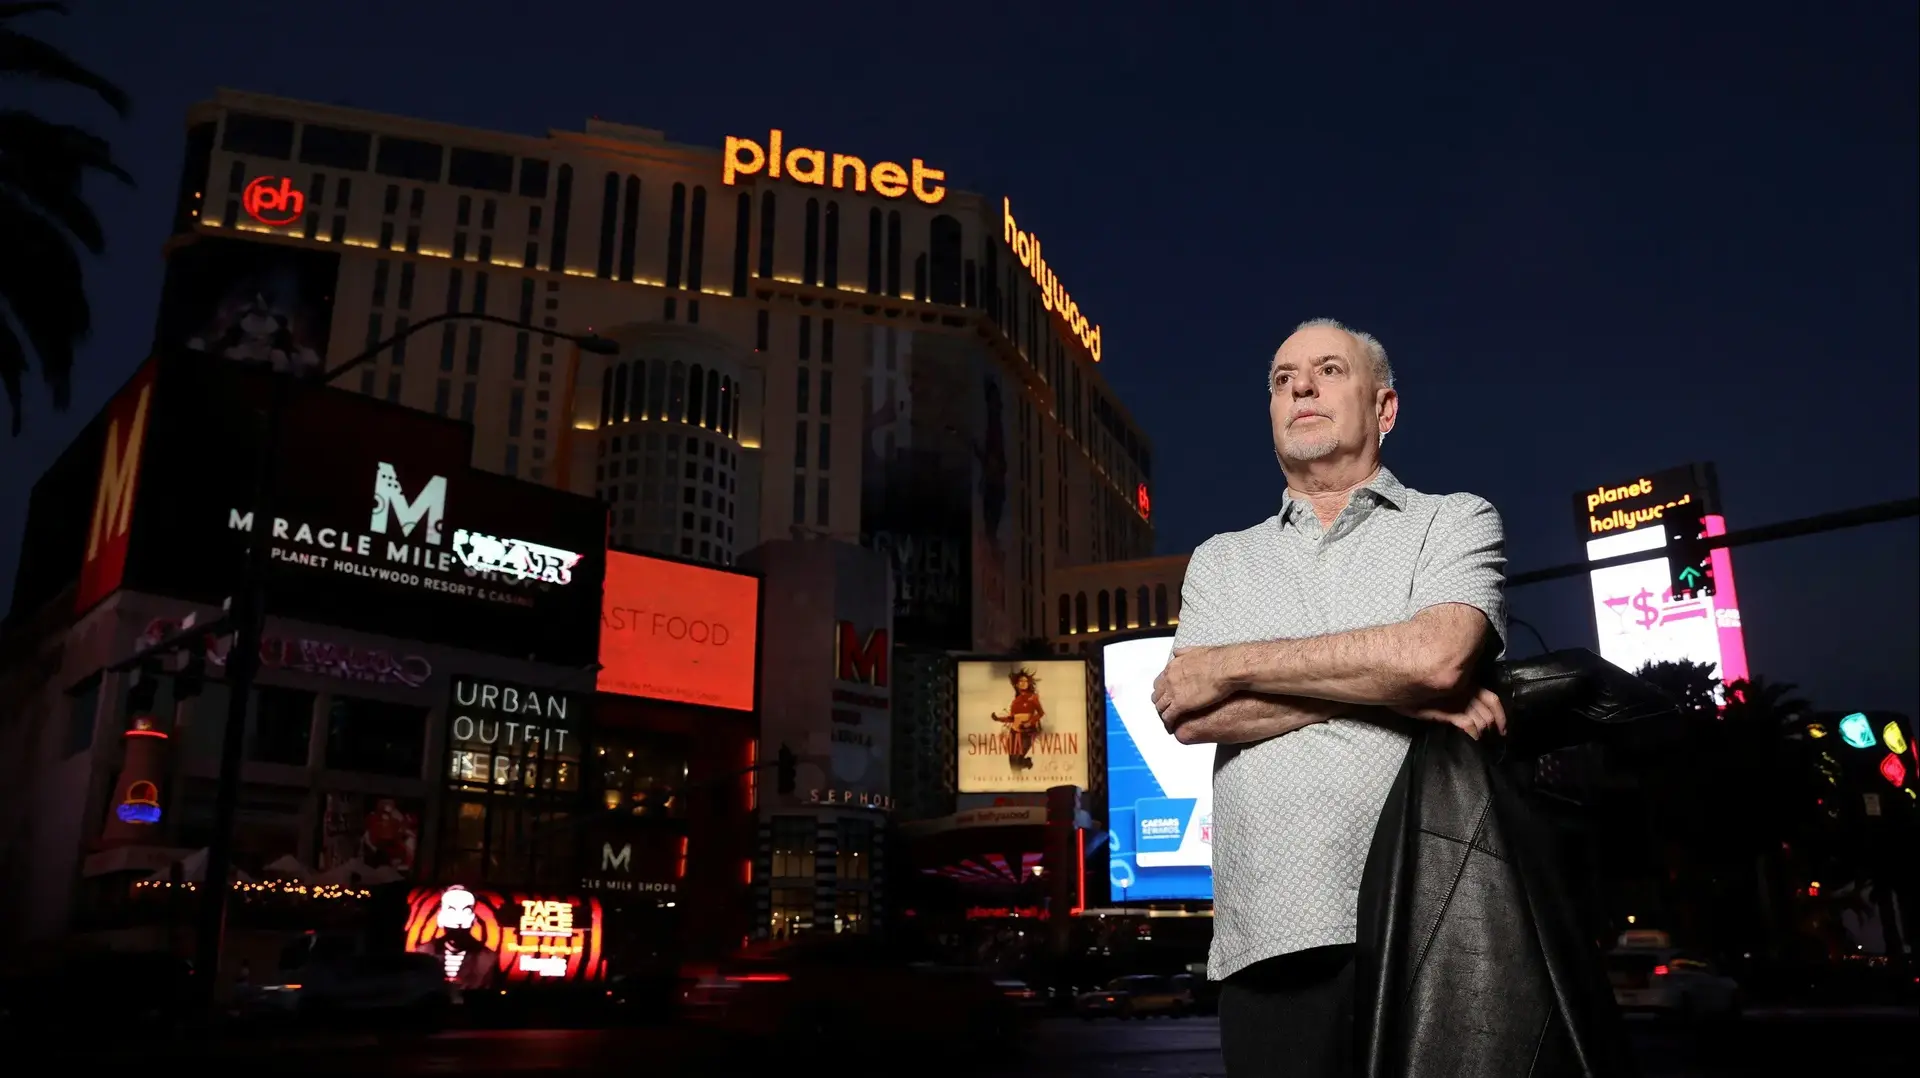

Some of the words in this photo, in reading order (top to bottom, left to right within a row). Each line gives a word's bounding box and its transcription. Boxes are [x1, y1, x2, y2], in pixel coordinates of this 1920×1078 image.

[723, 129, 945, 204] planet
[251, 176, 305, 214] ph
[1004, 196, 1101, 362] hollywood
[371, 461, 447, 546] M
[1586, 478, 1653, 513] planet
[1590, 494, 1690, 533] hollywo
[228, 508, 372, 556] MRACLE
[386, 541, 451, 572] MILE
[271, 547, 329, 569] PLANET
[333, 559, 420, 587] HOLLYWOOD
[423, 577, 474, 598] RESORT
[652, 613, 730, 647] FOOD
[835, 620, 888, 688] M
[456, 680, 567, 719] URBAN
[453, 715, 569, 752] OUTFIT
[967, 732, 1024, 756] SHANIA
[1030, 732, 1078, 755] TWAIN
[601, 841, 632, 873] M
[519, 915, 574, 932] FACE
[521, 900, 573, 917] TAPE
